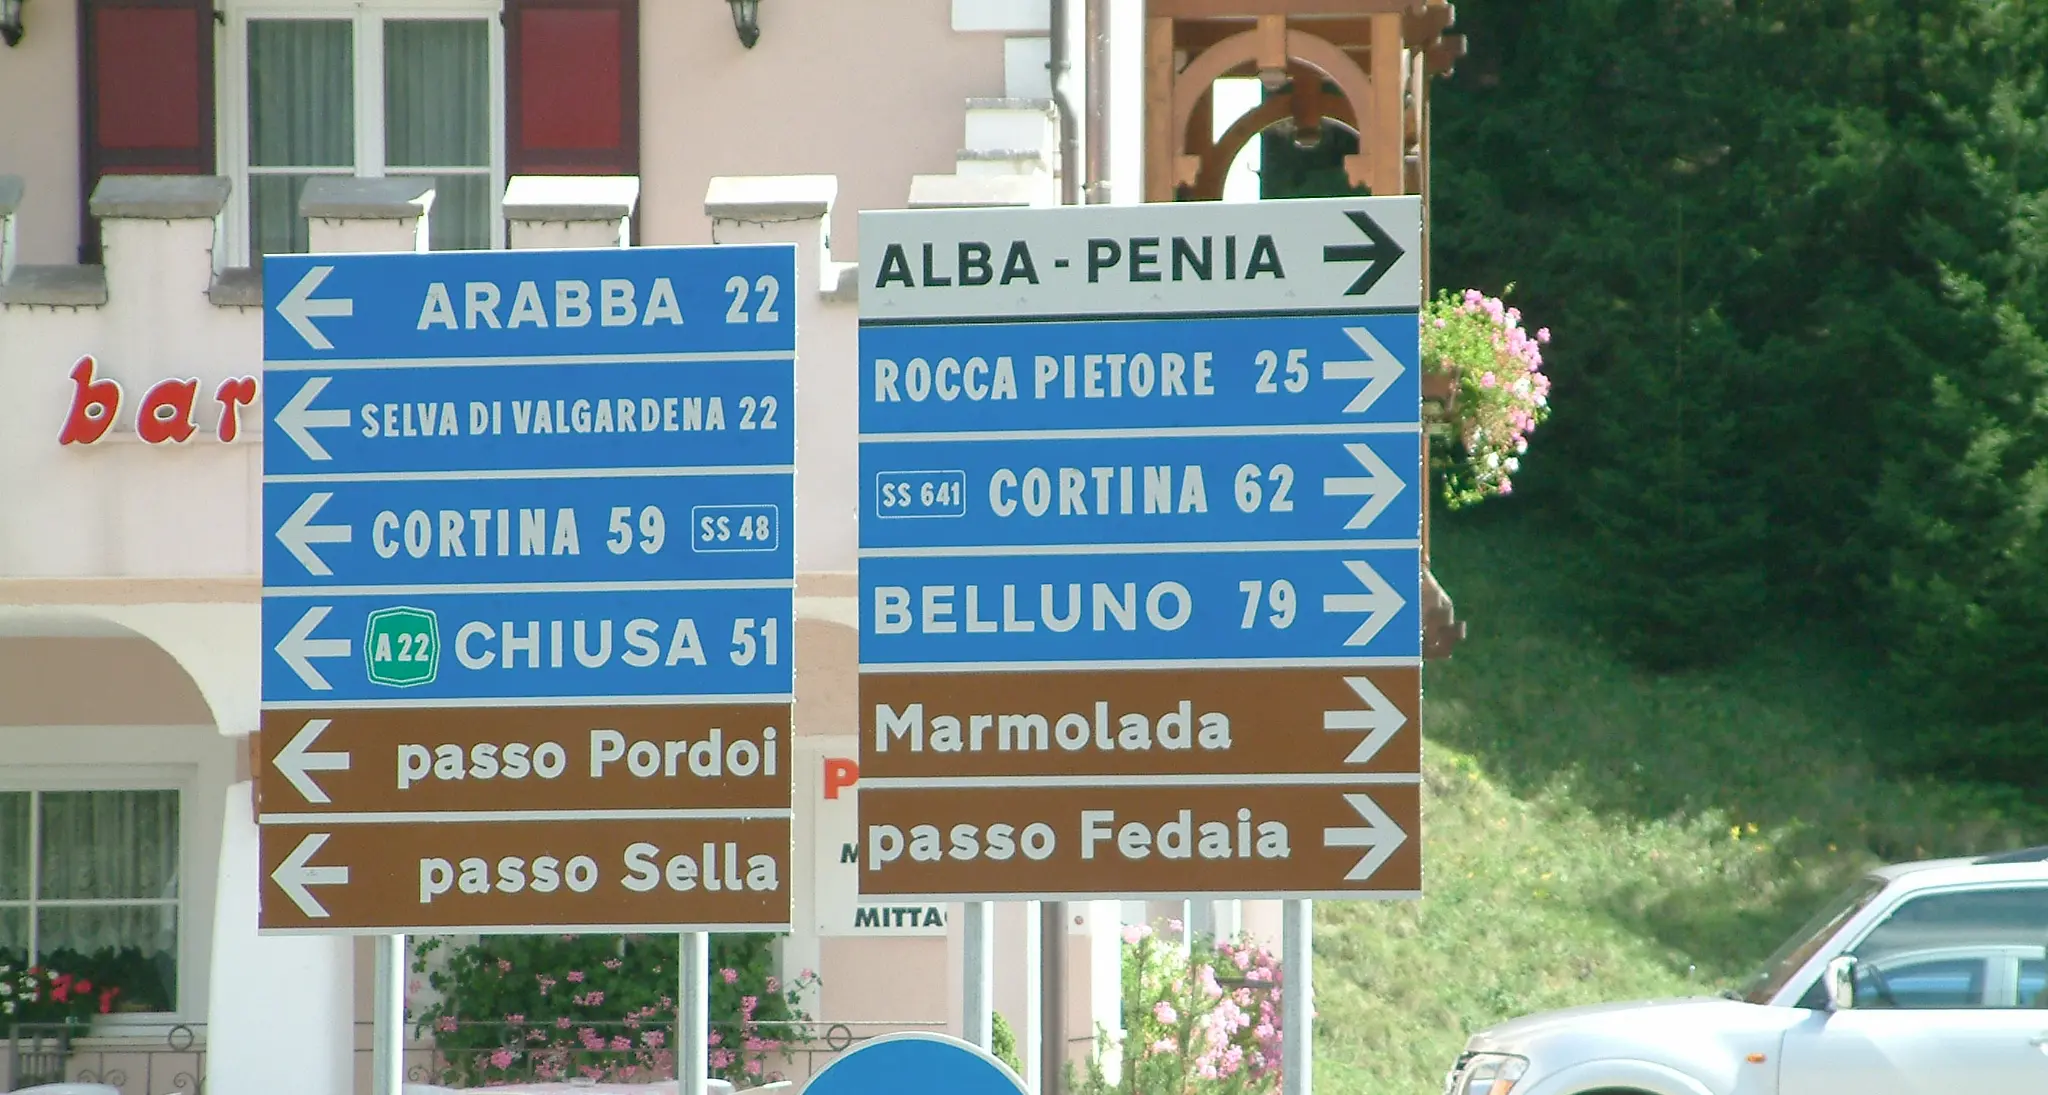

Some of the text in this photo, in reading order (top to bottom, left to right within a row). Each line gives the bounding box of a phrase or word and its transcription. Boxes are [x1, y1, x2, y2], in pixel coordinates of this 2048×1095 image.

[875, 240, 1040, 289] ALBA
[1087, 234, 1286, 284] PENIA
[417, 275, 779, 330] ARABBA 22
[59, 356, 257, 446] bar
[875, 349, 1309, 402] ROCCA PIETORE 25
[361, 395, 777, 438] SELVA DI VALGARDENA 22
[882, 463, 1294, 517] SS 641 CORTINA 62
[372, 505, 769, 559] CORTINA 59 SS 48
[875, 579, 1297, 634] BELLUNO 79
[374, 617, 777, 670] A 22 CHIUSA 51
[875, 700, 1232, 753] Marmolada
[397, 726, 777, 789] passo Pordoi
[869, 807, 1291, 871] passo Fedaia
[419, 842, 779, 904] passo Sella
[854, 907, 948, 927] MITTA
